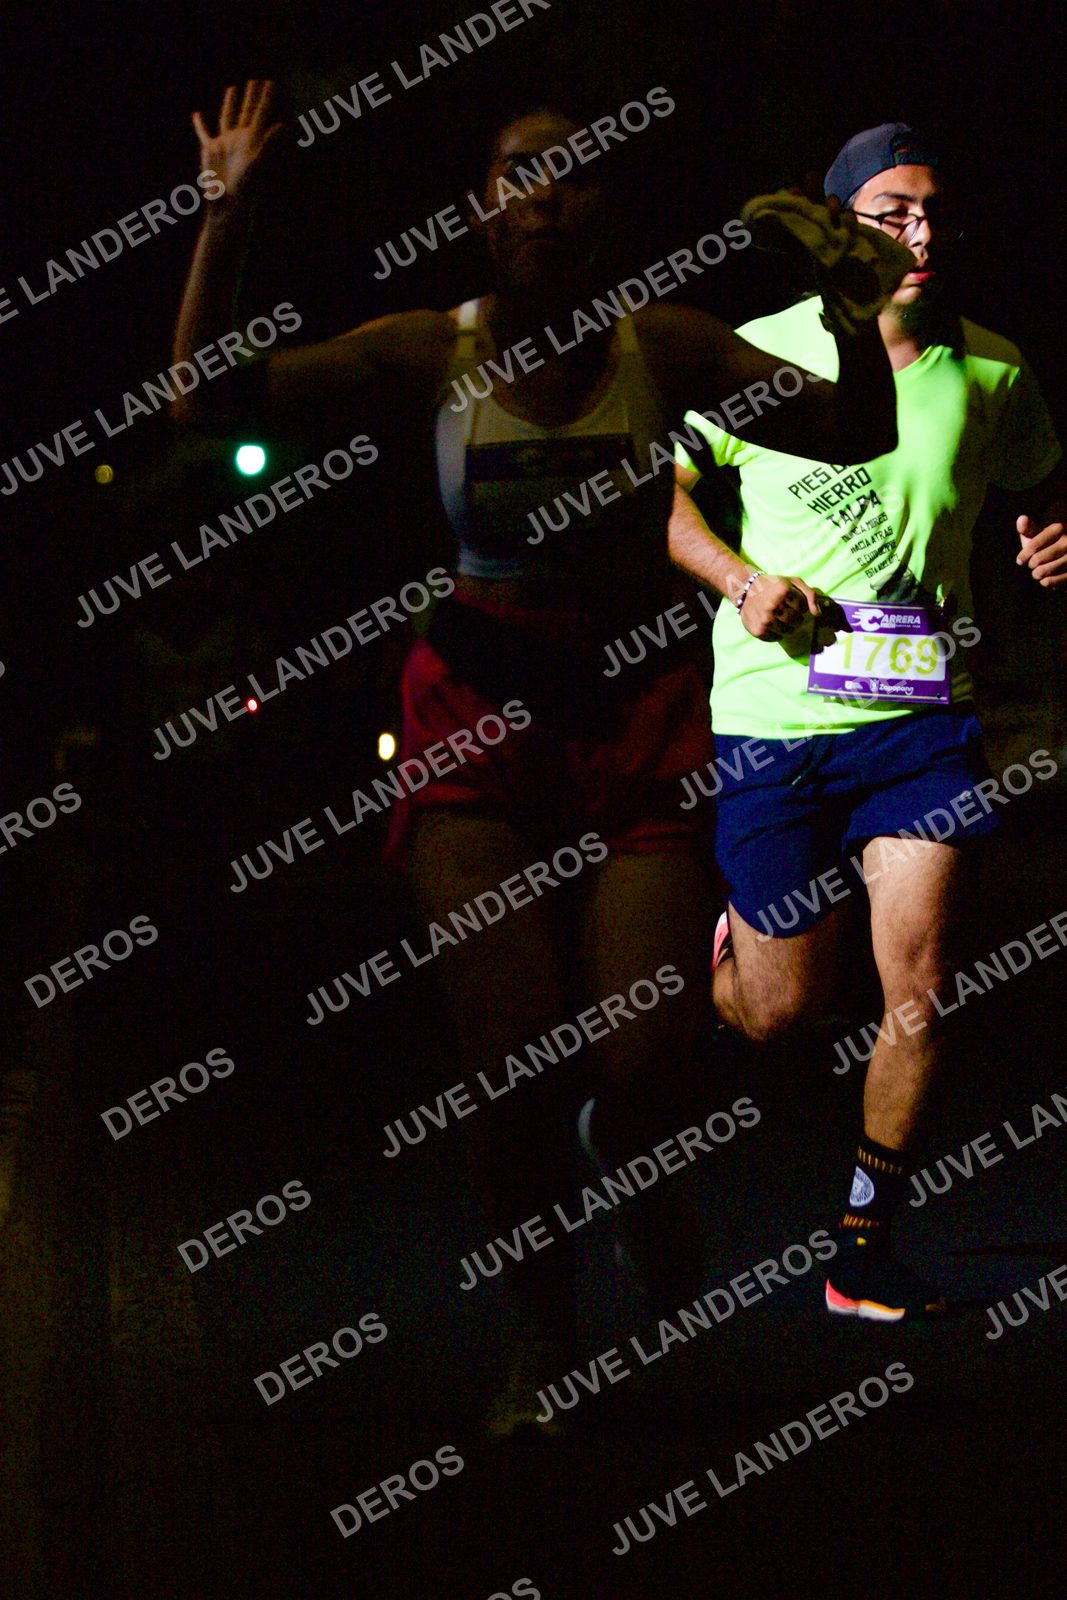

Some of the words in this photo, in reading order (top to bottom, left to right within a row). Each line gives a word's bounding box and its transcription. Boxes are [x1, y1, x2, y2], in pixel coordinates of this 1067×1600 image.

[788, 467, 832, 500] PIES
[807, 466, 872, 514] HIERRO
[826, 489, 881, 528] TALPA
[850, 538, 871, 554] HACIA
[871, 526, 894, 544] ATRAS
[838, 633, 938, 675] 1769
